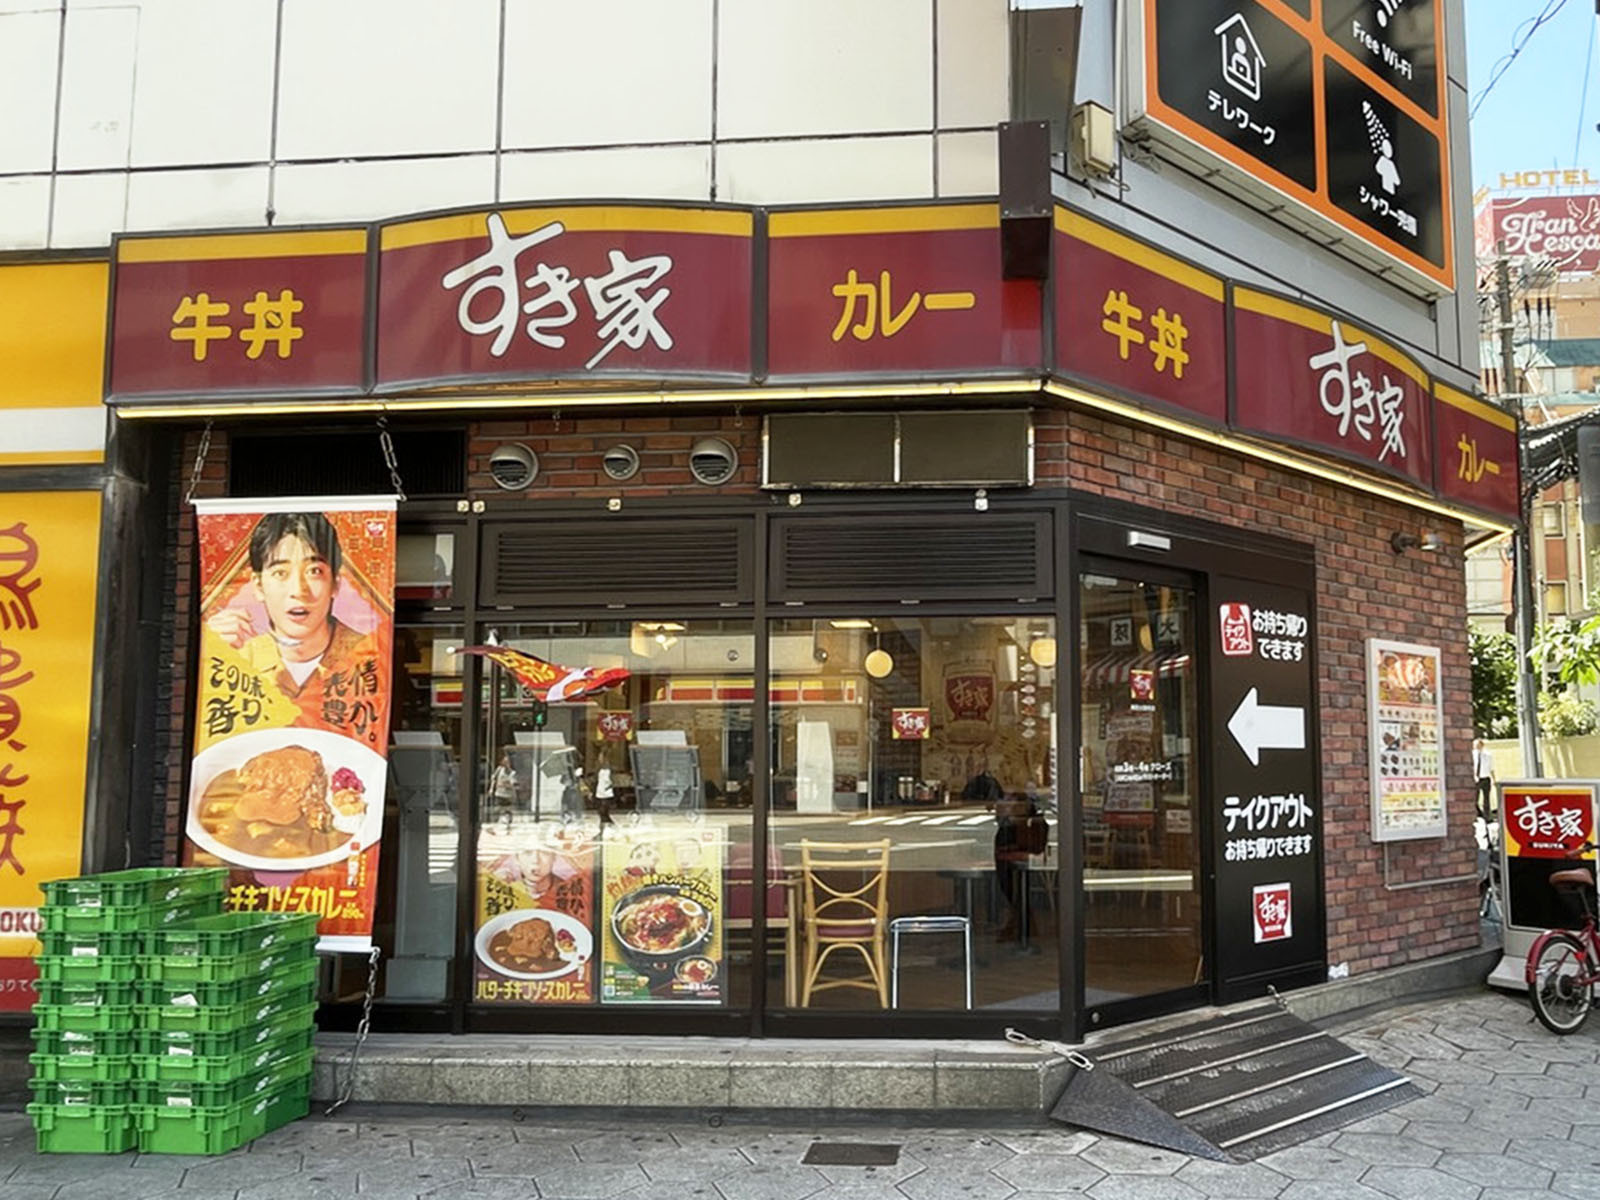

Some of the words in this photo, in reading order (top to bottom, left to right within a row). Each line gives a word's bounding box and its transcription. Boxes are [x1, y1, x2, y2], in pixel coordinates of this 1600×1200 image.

[1353, 20, 1380, 54] Free
[1382, 43, 1412, 80] Wi-Fi
[1208, 89, 1276, 145] テレワーク
[1500, 169, 1599, 188] HOTEL
[443, 212, 674, 370] すき家
[832, 269, 976, 342] カレー
[170, 289, 304, 361] 牛丼
[1102, 289, 1190, 379] 牛丼
[1309, 319, 1406, 462] すき家
[1458, 433, 1500, 482] カレー
[1253, 608, 1308, 638] お持ち帰り
[1257, 638, 1305, 662] できます
[1223, 793, 1314, 833] テイクアウト
[1513, 796, 1584, 842] すき家
[1225, 835, 1313, 861] お持ち帰りできます
